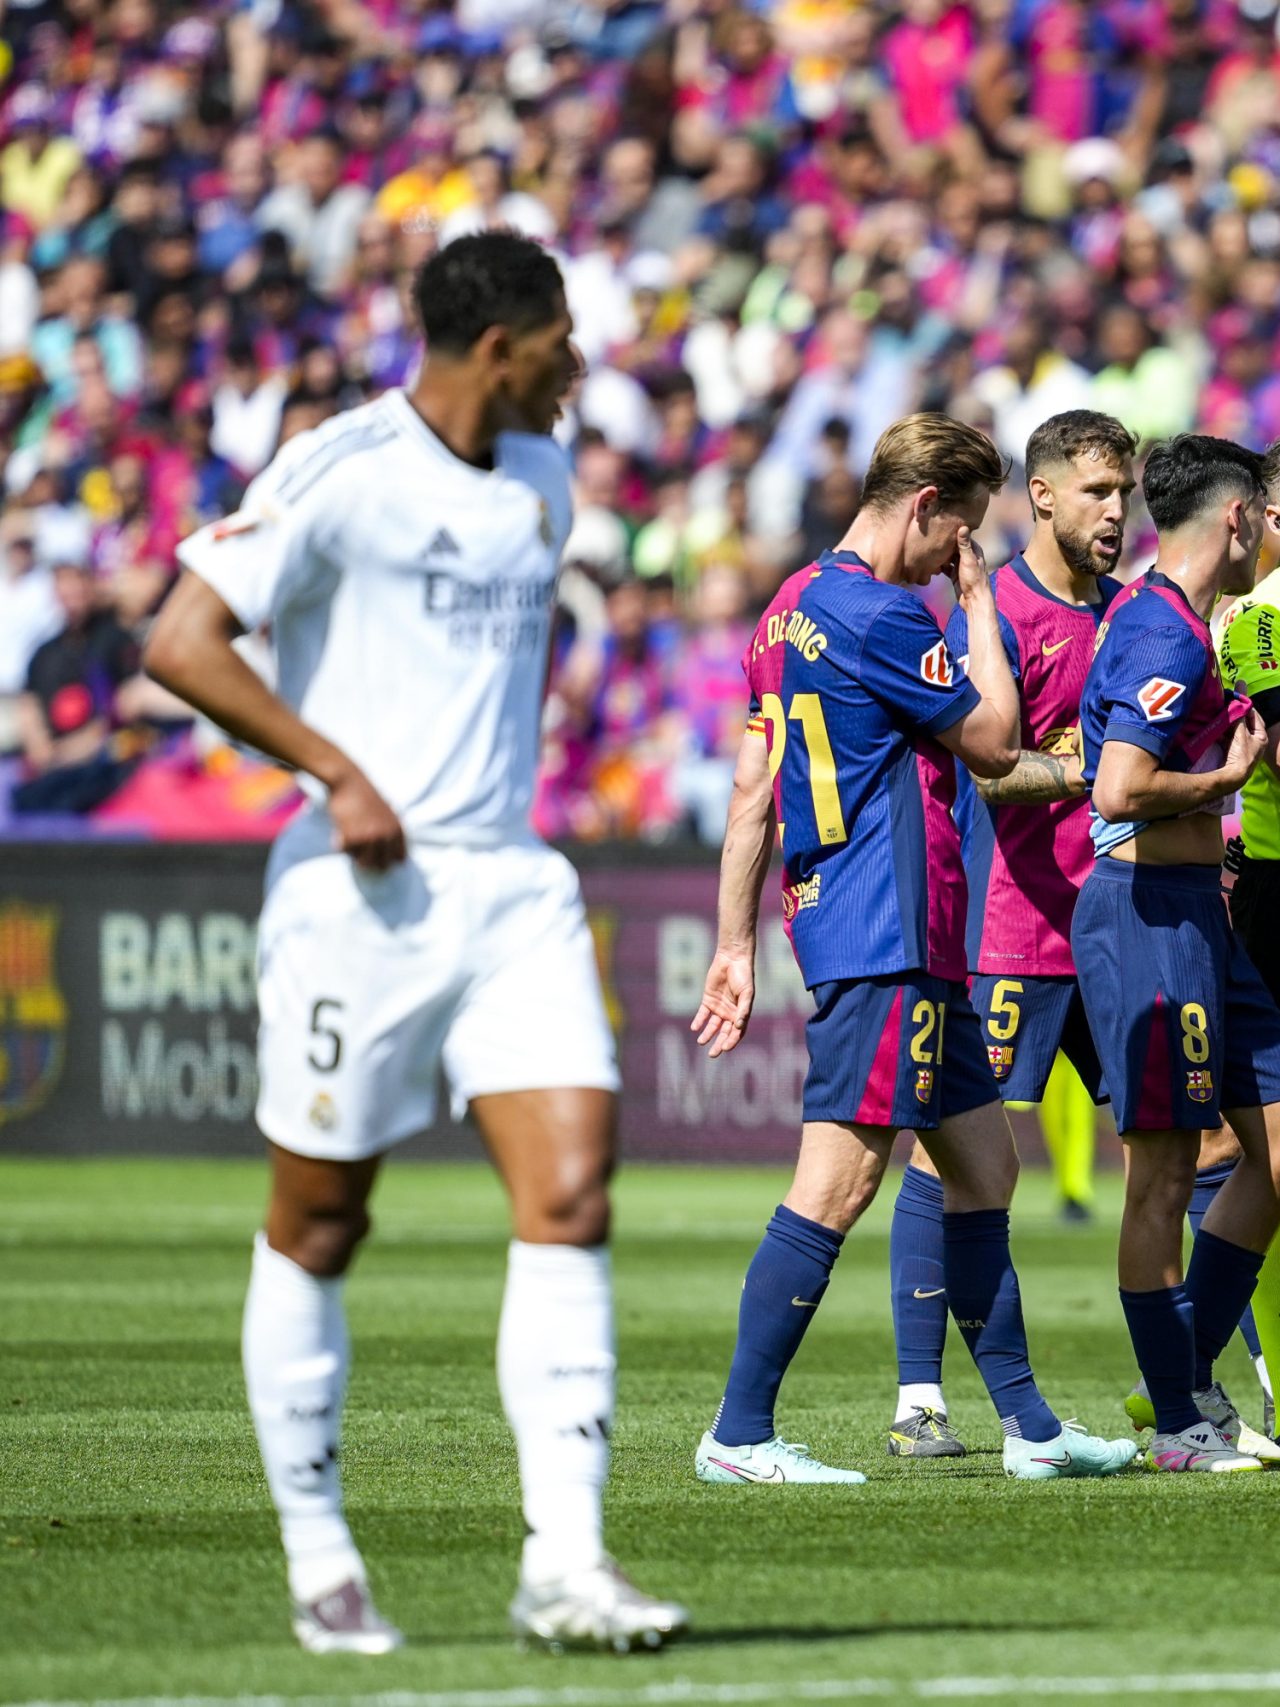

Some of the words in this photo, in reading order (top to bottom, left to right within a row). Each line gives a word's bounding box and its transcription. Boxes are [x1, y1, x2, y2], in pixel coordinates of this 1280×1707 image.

[767, 610, 788, 648] DE
[308, 1000, 342, 1073] 5
[910, 999, 946, 1065] 21
[986, 979, 1025, 1040] 5
[1179, 1002, 1210, 1064] 8
[101, 1018, 260, 1122] Mob
